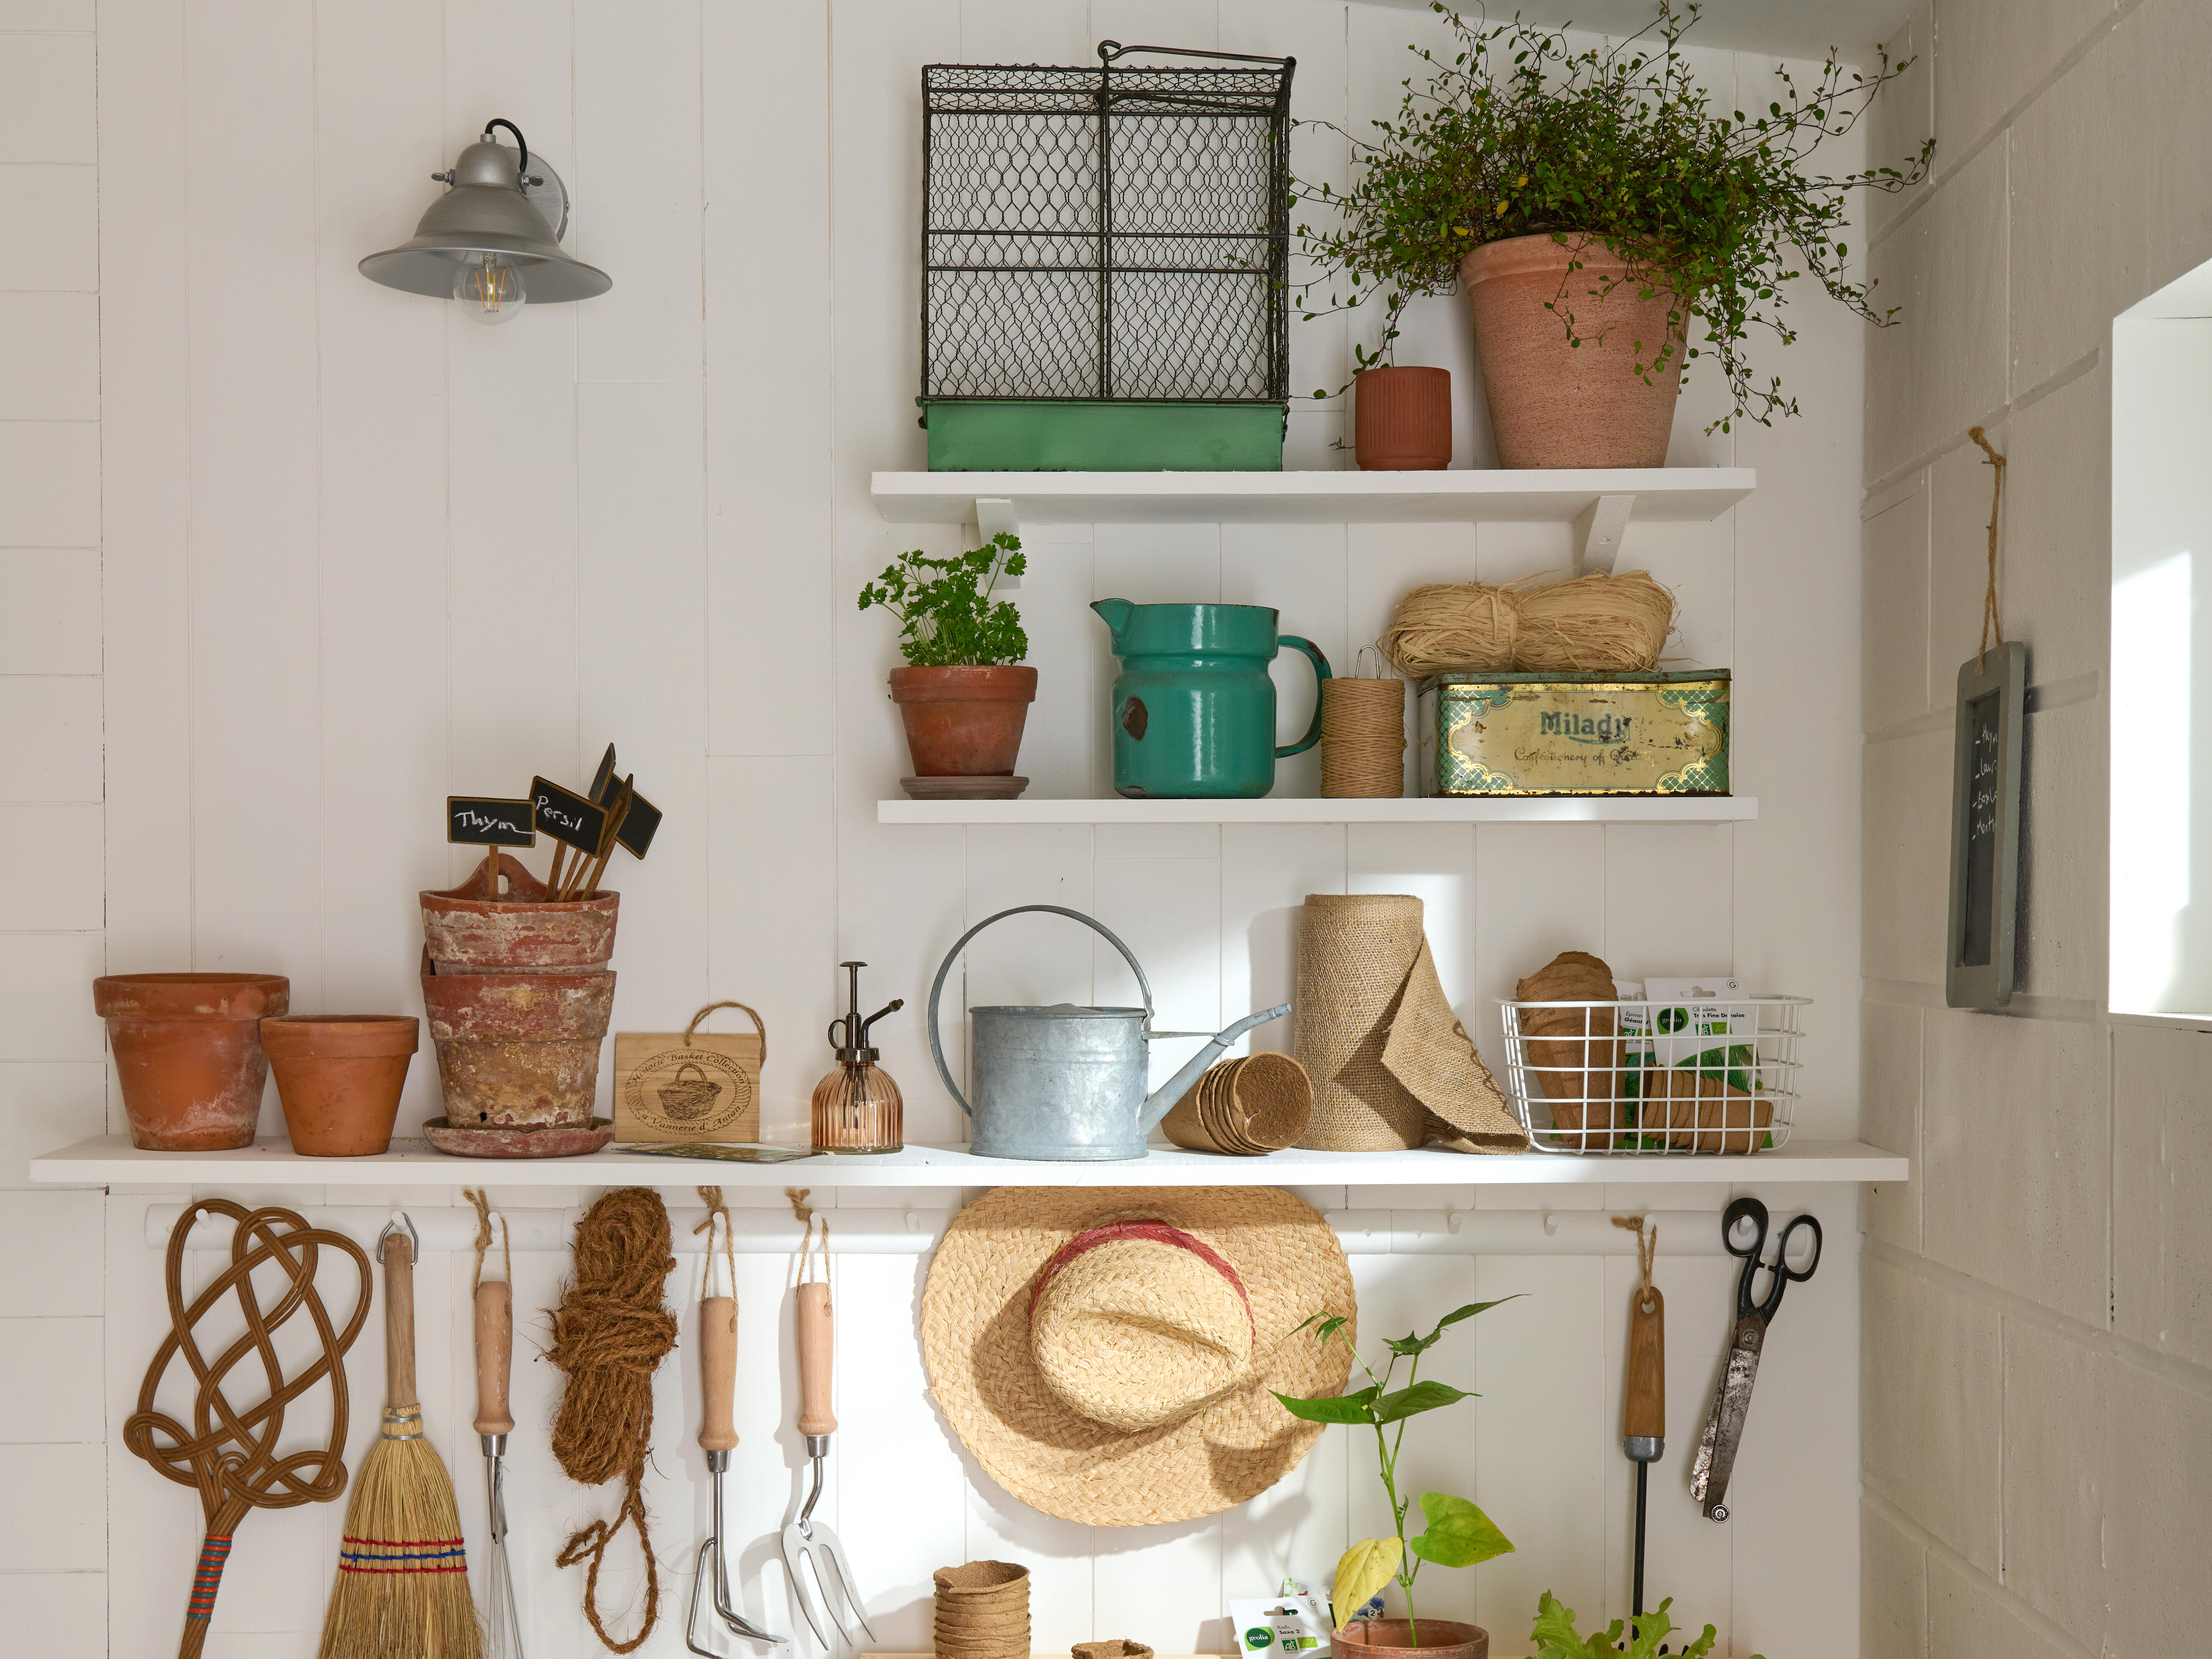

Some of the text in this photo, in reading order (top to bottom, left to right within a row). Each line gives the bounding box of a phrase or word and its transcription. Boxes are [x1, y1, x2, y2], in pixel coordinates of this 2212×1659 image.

[1539, 711, 1631, 745] Milady
[1514, 746, 1587, 768] Confectionery
[1593, 748, 1605, 766] of
[536, 795, 583, 831] Persil
[632, 1053, 745, 1086] Historic Basket Collection
[634, 1107, 648, 1120] La
[651, 1117, 696, 1131] Vannerie
[713, 1105, 740, 1127] Antan
